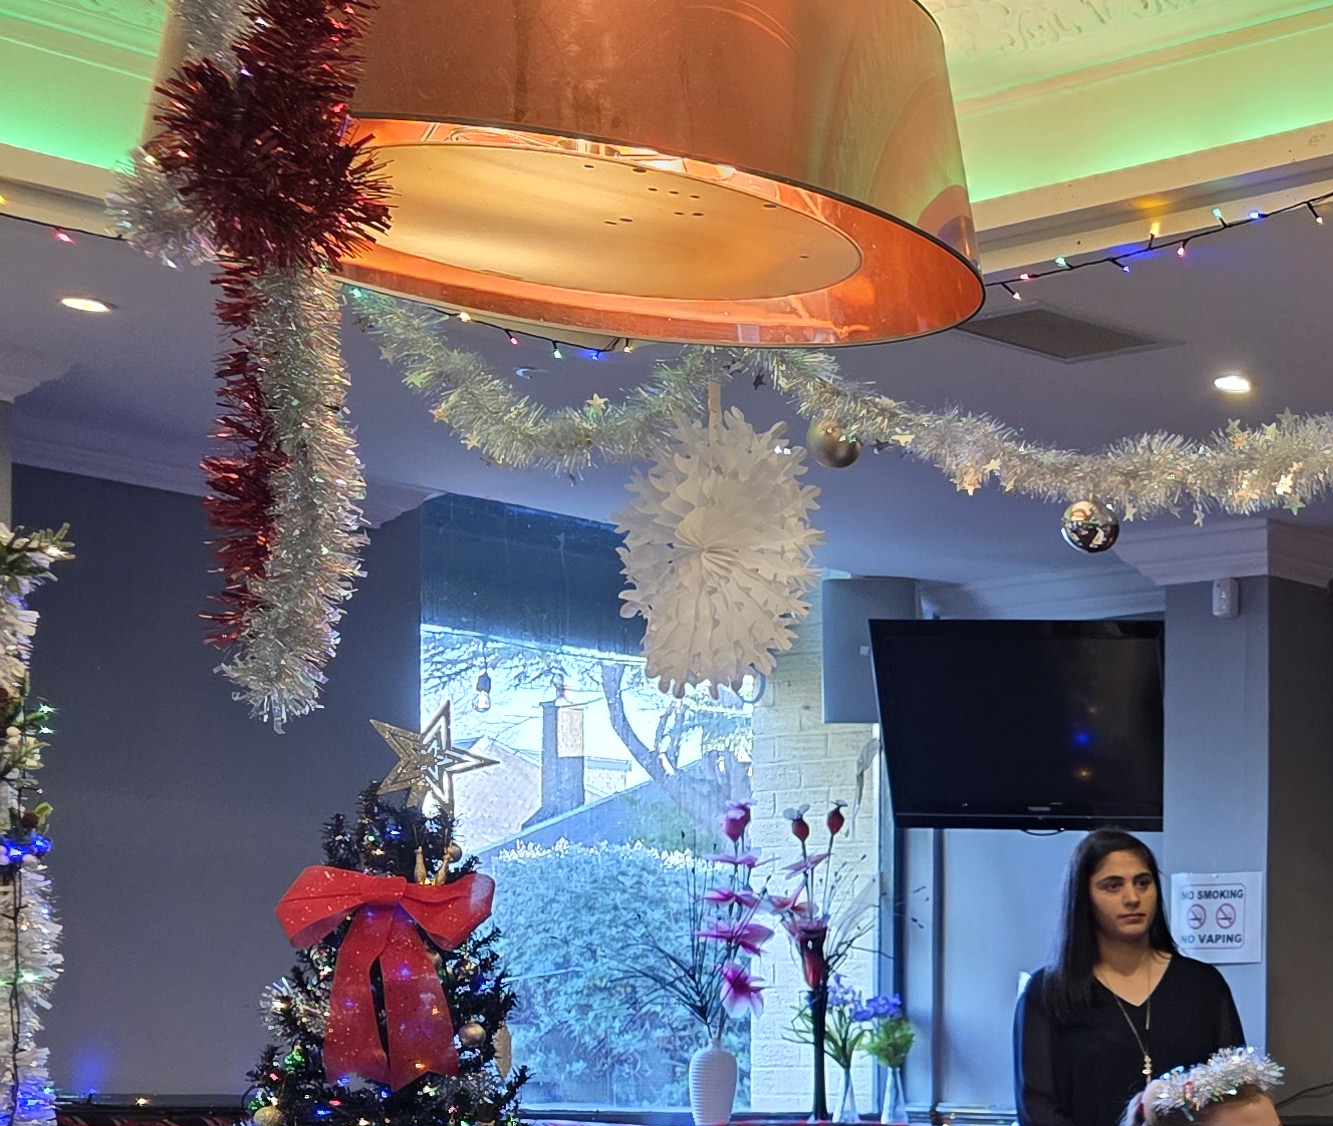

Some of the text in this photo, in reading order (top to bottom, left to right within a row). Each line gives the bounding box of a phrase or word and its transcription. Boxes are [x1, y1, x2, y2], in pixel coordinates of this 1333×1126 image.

[1181, 889, 1244, 900] NO SMOKING
[1181, 933, 1243, 944] NO VAPING
